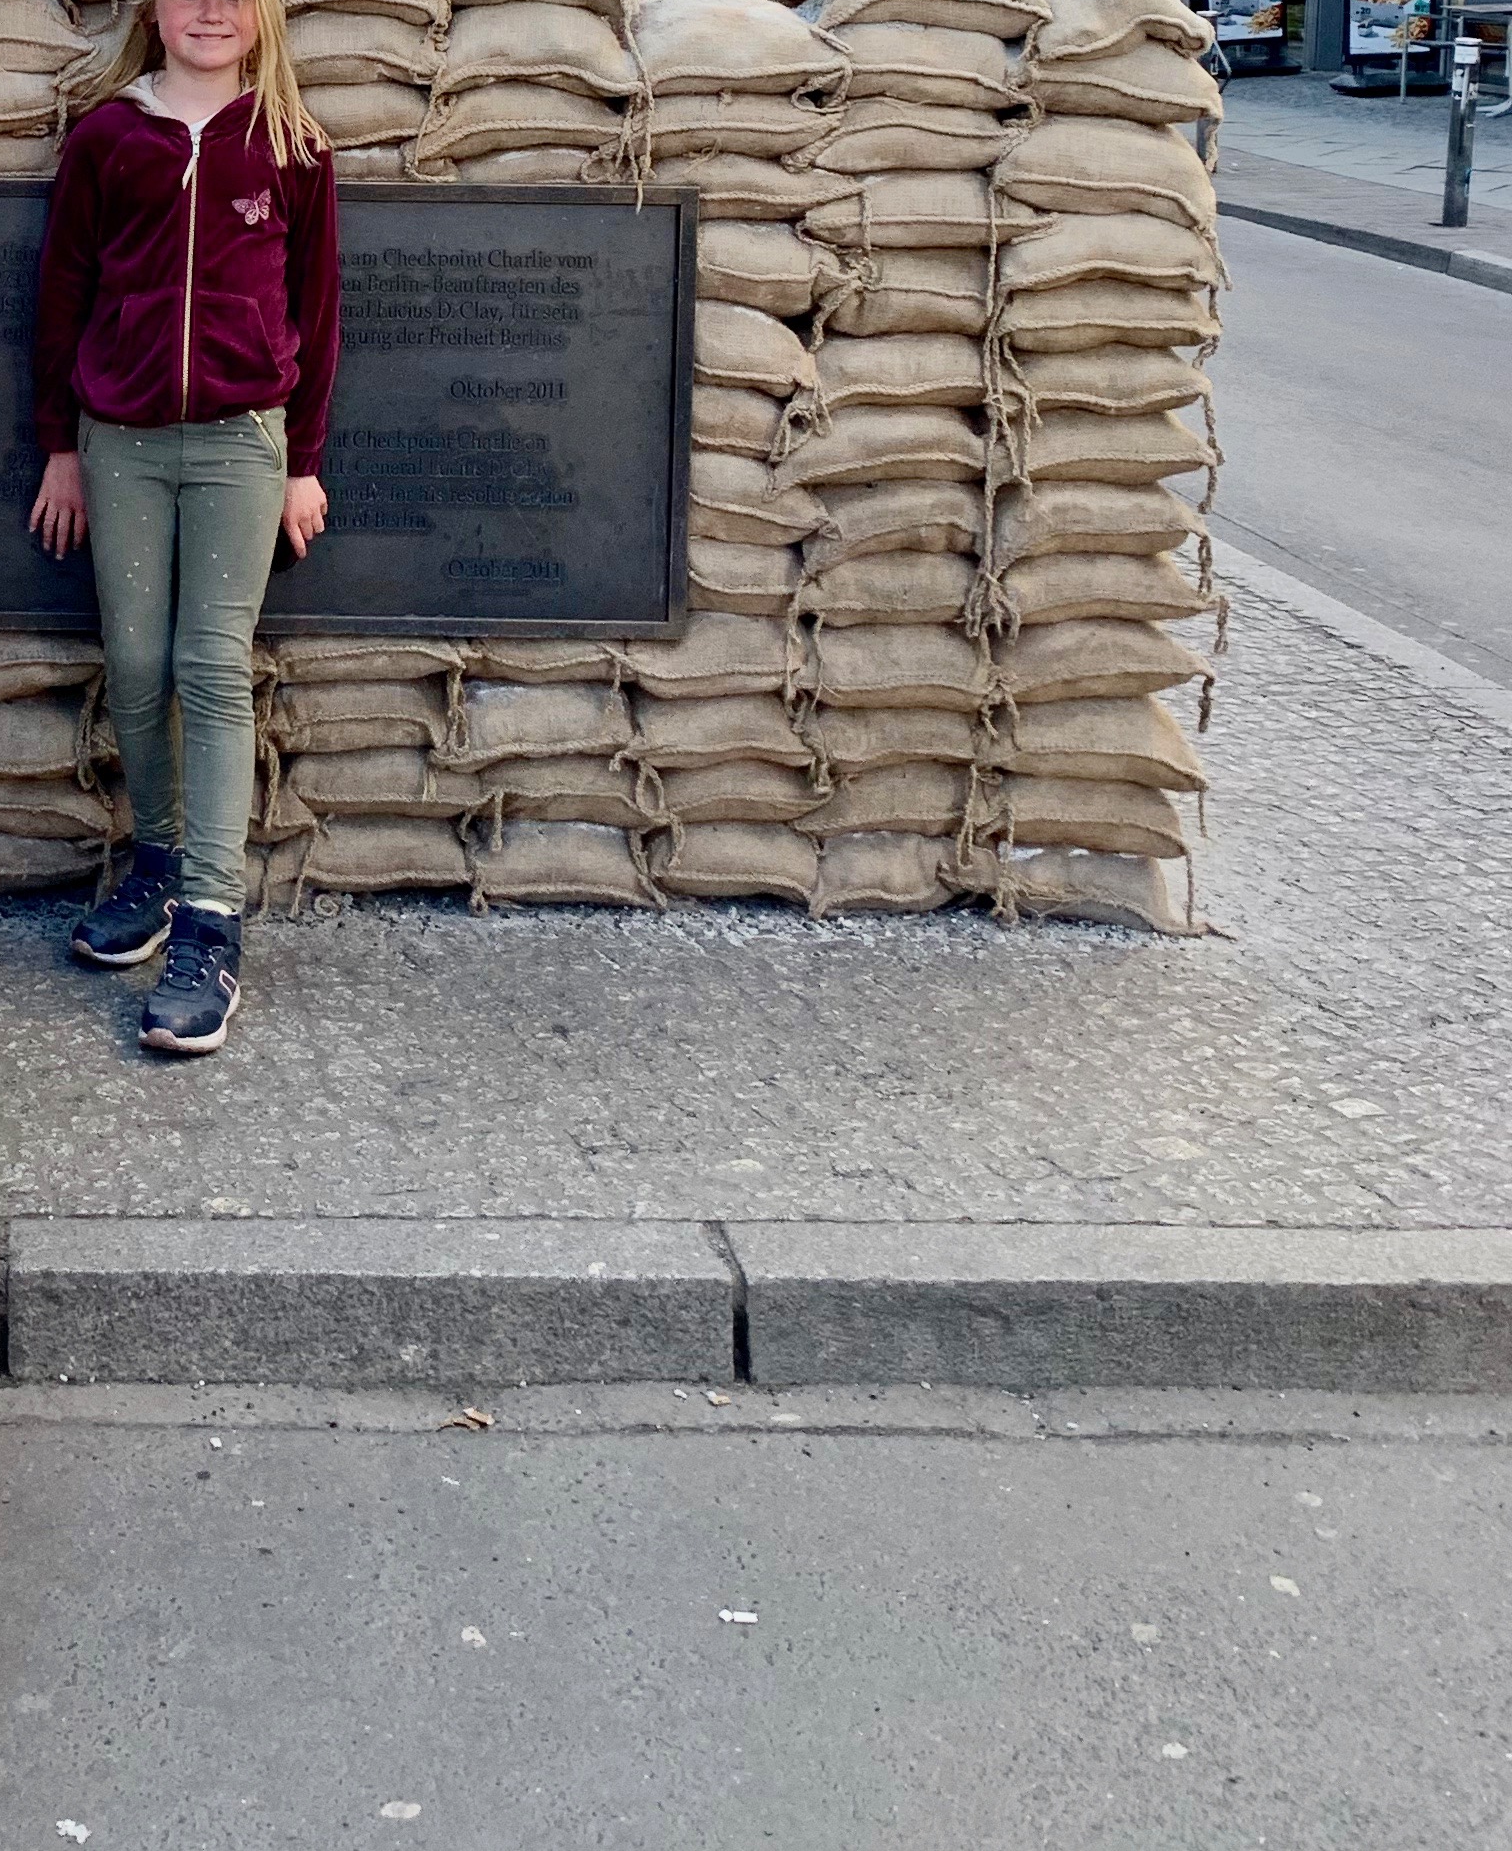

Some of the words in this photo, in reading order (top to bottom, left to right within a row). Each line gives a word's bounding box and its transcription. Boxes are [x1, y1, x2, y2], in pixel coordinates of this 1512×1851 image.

[383, 249, 484, 273] Checkpoint
[488, 249, 552, 269] Charlie
[558, 253, 594, 269] vom
[550, 276, 579, 294] des
[376, 302, 432, 319] Lucius
[459, 302, 504, 322] Clay,
[542, 304, 579, 321] sein
[396, 328, 425, 345] der
[430, 327, 495, 346] Freiheit
[450, 380, 522, 399] Oktober
[527, 381, 566, 399] 2011
[352, 430, 452, 453] Checkpoint
[448, 559, 519, 579] October
[522, 560, 562, 580] 2011
